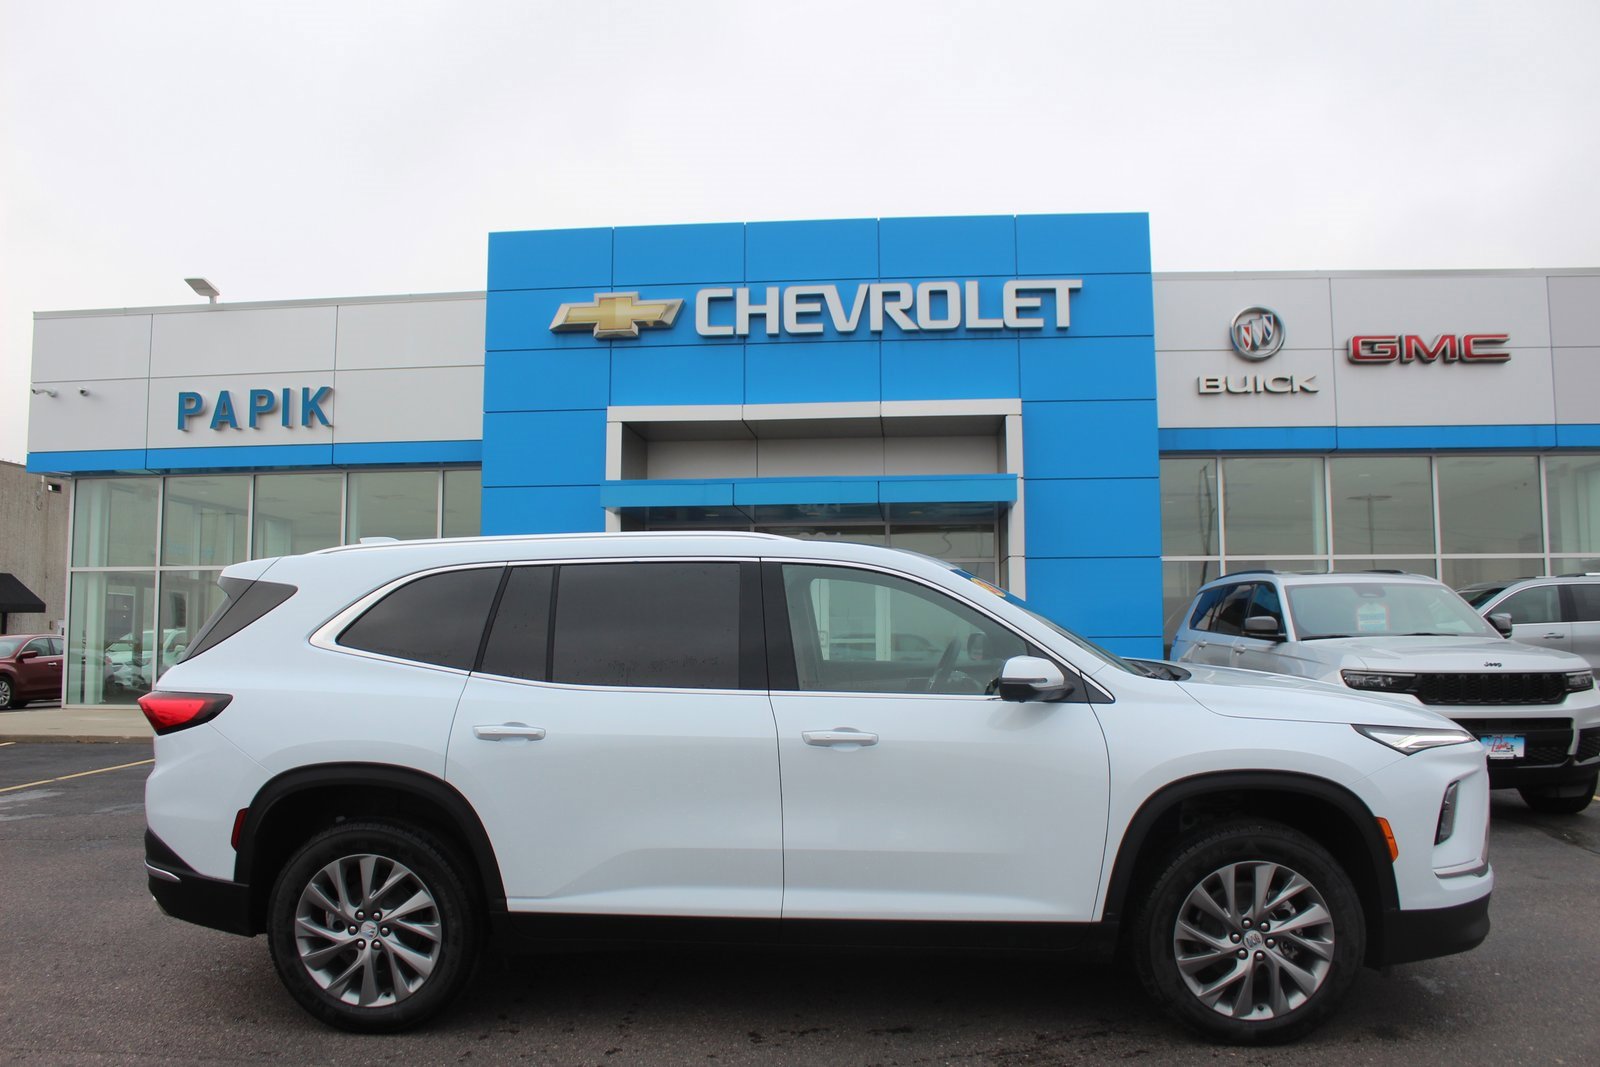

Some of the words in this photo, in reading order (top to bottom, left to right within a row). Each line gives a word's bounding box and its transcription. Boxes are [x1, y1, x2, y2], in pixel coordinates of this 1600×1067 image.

[695, 279, 1083, 336] CHEVROLET
[1347, 334, 1511, 364] GMC
[1197, 375, 1319, 394] BUICK
[177, 386, 333, 431] PAPIK
